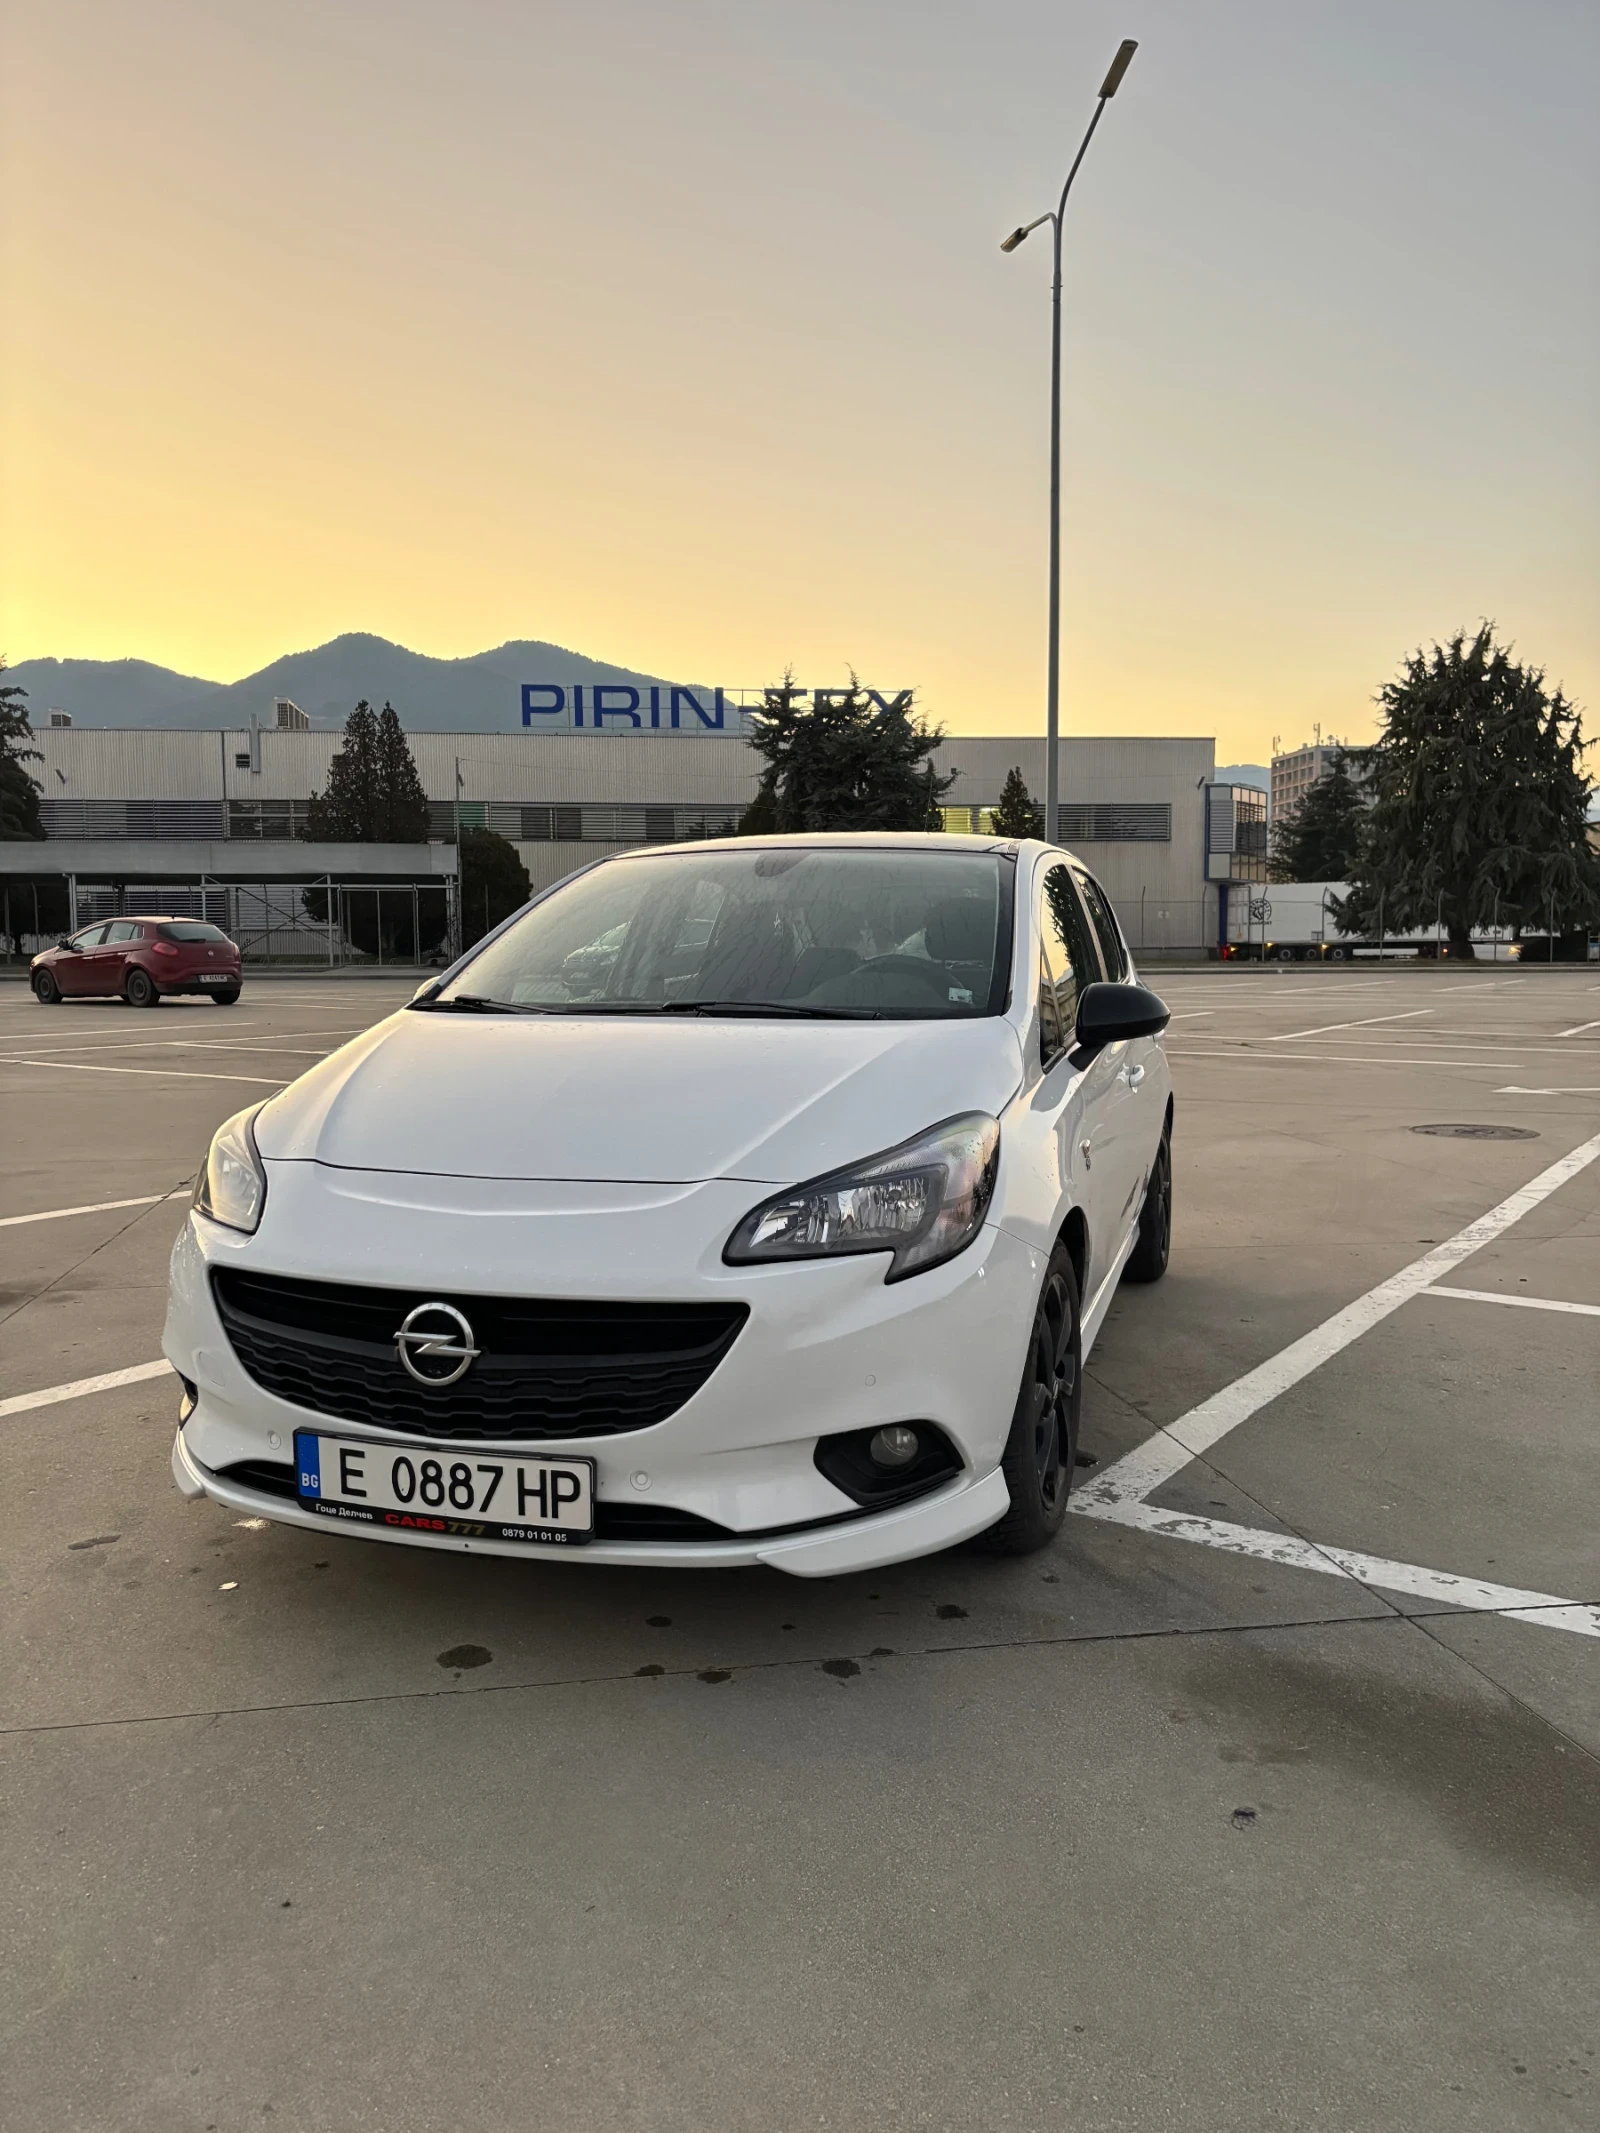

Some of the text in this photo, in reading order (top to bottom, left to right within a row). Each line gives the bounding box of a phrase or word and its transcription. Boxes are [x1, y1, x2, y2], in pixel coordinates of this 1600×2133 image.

[301, 1472, 319, 1488] BG
[339, 1447, 581, 1519] E 0887 HP
[315, 1503, 373, 1520] Гоце Делчев
[502, 1528, 567, 1542] 0879 01 01 05
